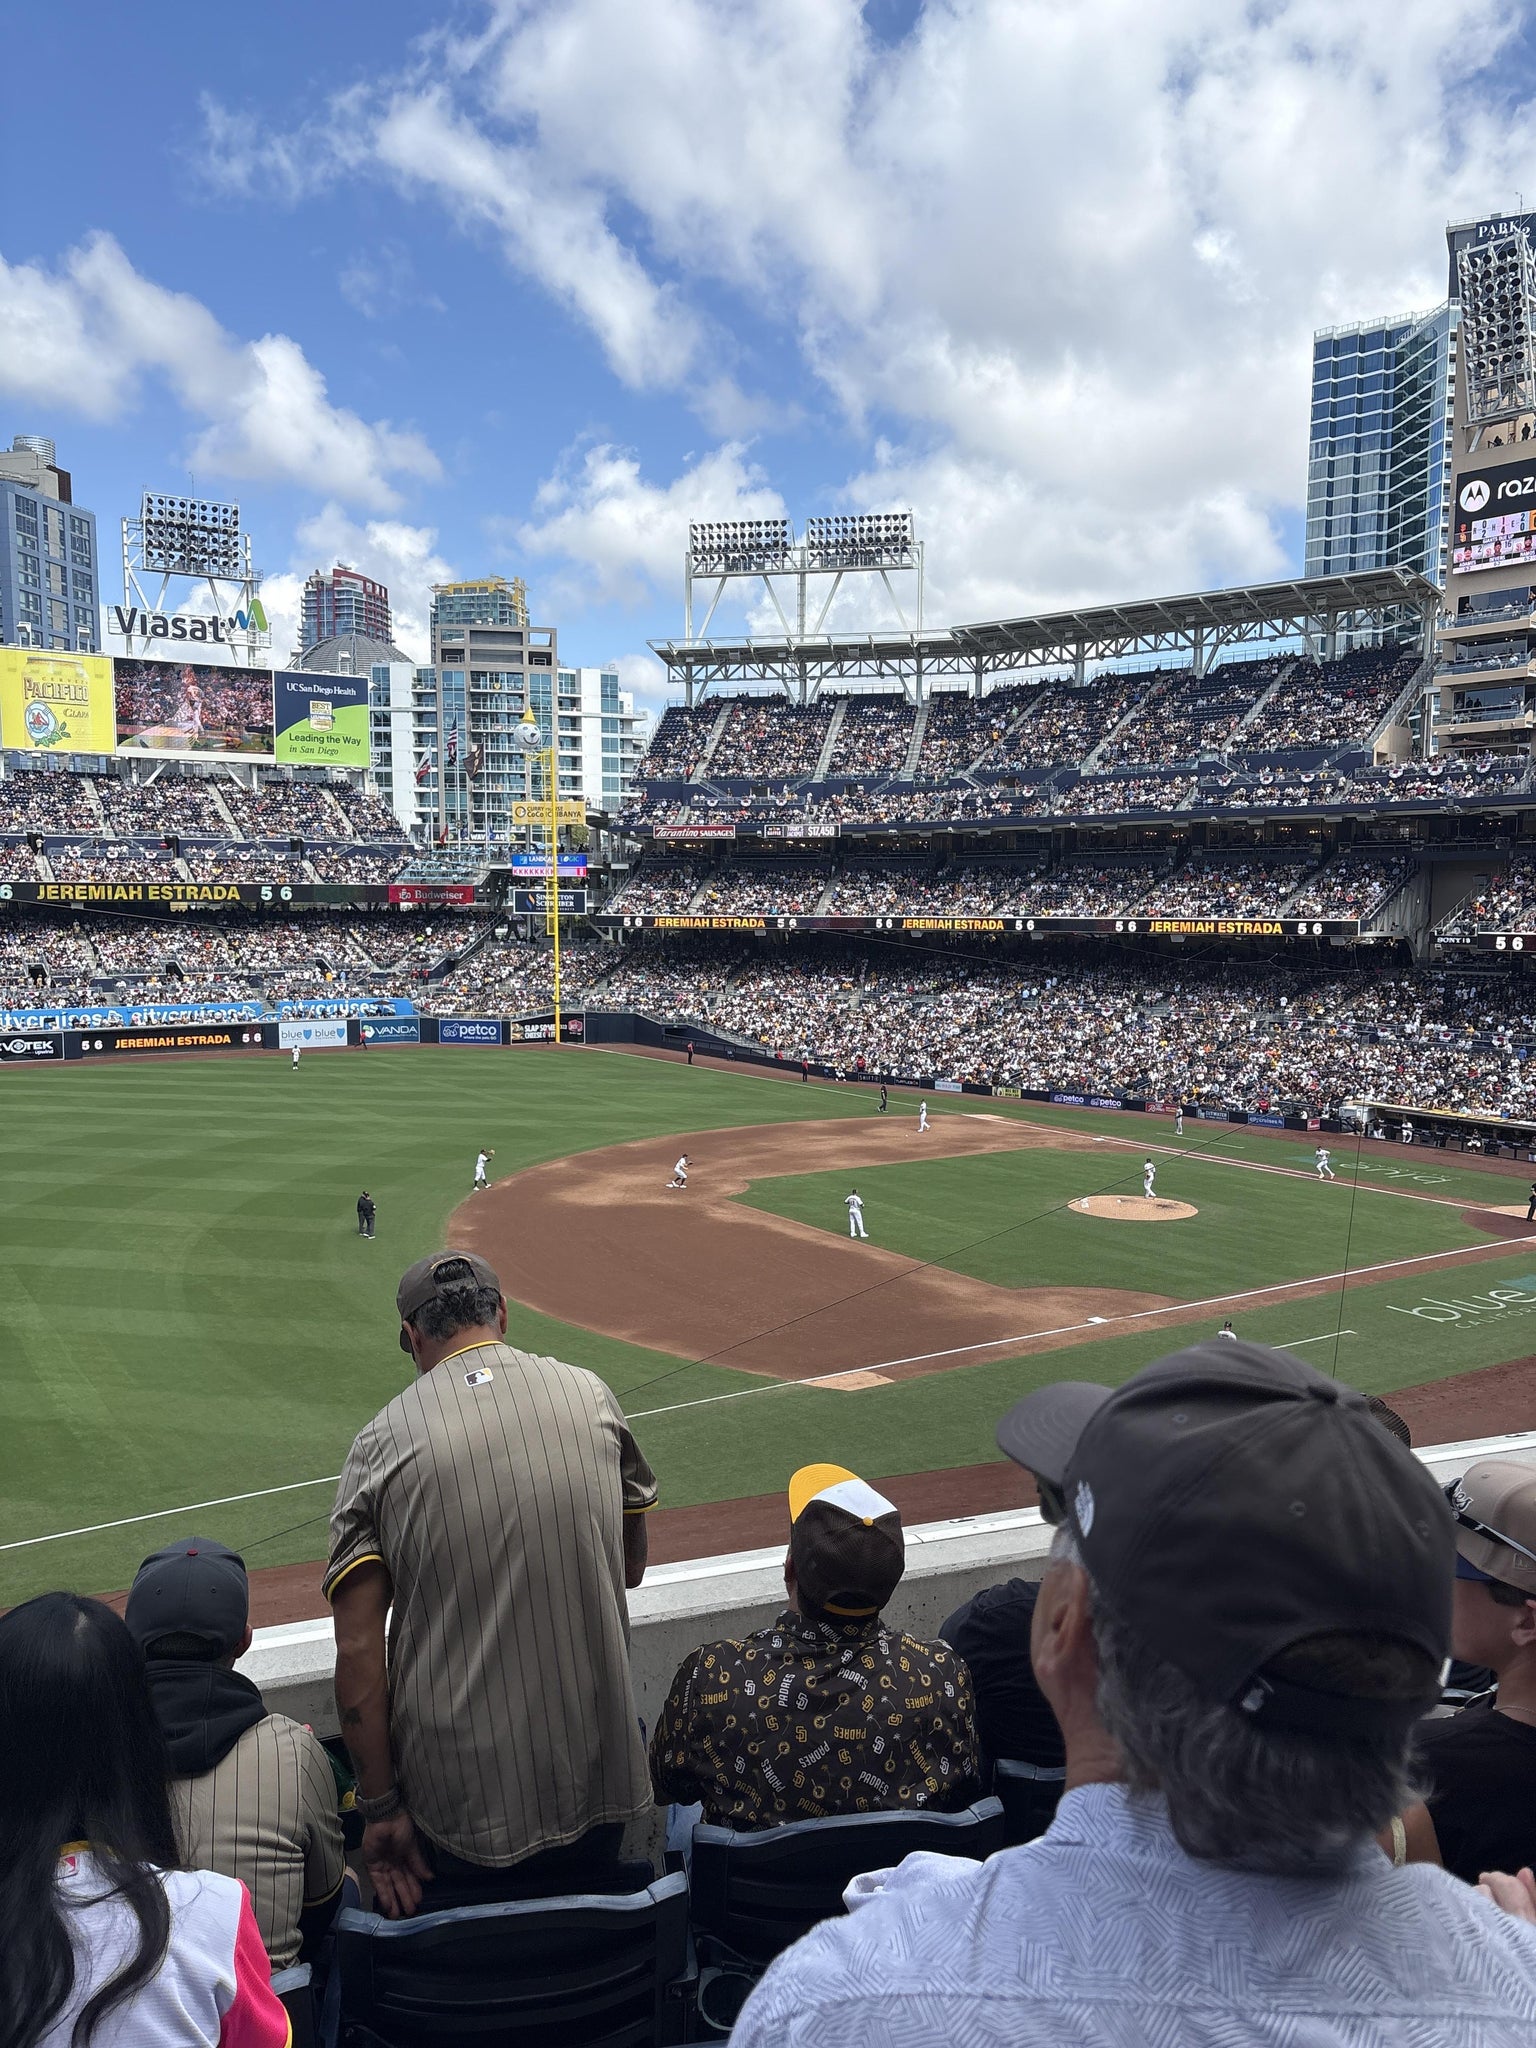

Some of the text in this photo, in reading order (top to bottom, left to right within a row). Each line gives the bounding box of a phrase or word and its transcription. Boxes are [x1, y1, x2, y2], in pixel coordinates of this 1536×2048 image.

[1478, 219, 1519, 238] PARK
[1497, 476, 1536, 500] raz
[1520, 513, 1525, 521] 2
[1501, 526, 1506, 534] 4
[1520, 522, 1525, 531] 0
[1481, 530, 1486, 538] 2
[1504, 540, 1511, 548] 16
[115, 606, 225, 642] Viasat
[24, 677, 88, 701] PACIFICO
[287, 682, 356, 696] UC San Diego Health
[312, 702, 330, 710] BEST
[289, 733, 325, 744] Leading
[342, 736, 361, 747] Way
[317, 747, 339, 756] Diego
[655, 827, 699, 838] Tarantino
[807, 826, 835, 836] $17,450
[0, 884, 13, 899] 6
[37, 884, 241, 900] JEREMIAH ESTRADA
[261, 886, 292, 900] 5 6
[415, 890, 464, 900] Budweiser
[654, 917, 766, 928] JEREMIAH ESTRADA
[902, 919, 1004, 930] JEREMIAH ESTRADA
[1149, 921, 1283, 934] JEREMIAH ESTRADA
[1495, 936, 1523, 950] 5 6
[281, 1030, 302, 1039] blue
[315, 1028, 336, 1037] blue
[375, 1025, 418, 1035] VANDA
[459, 1025, 497, 1037] petco
[82, 1040, 103, 1050] 5 6
[115, 1035, 231, 1049] JEREMIAH ESTRADA
[242, 1033, 261, 1043] 5 6
[1062, 1094, 1084, 1103] petco
[1100, 1099, 1122, 1107] petco
[1386, 1290, 1536, 1322] blue
[901, 1635, 930, 1656] PADRES
[837, 1668, 869, 1691] PADRES
[778, 1673, 796, 1708] PADRES
[905, 1692, 935, 1709] PADRES
[833, 1725, 867, 1741] PADRES
[702, 1734, 725, 1769] PADRES
[798, 1740, 831, 1769] PADRES
[908, 1739, 932, 1774] PADRES
[760, 1758, 786, 1793] PADRES
[858, 1770, 890, 1796] PADRES
[733, 1779, 762, 1808] PADRES
